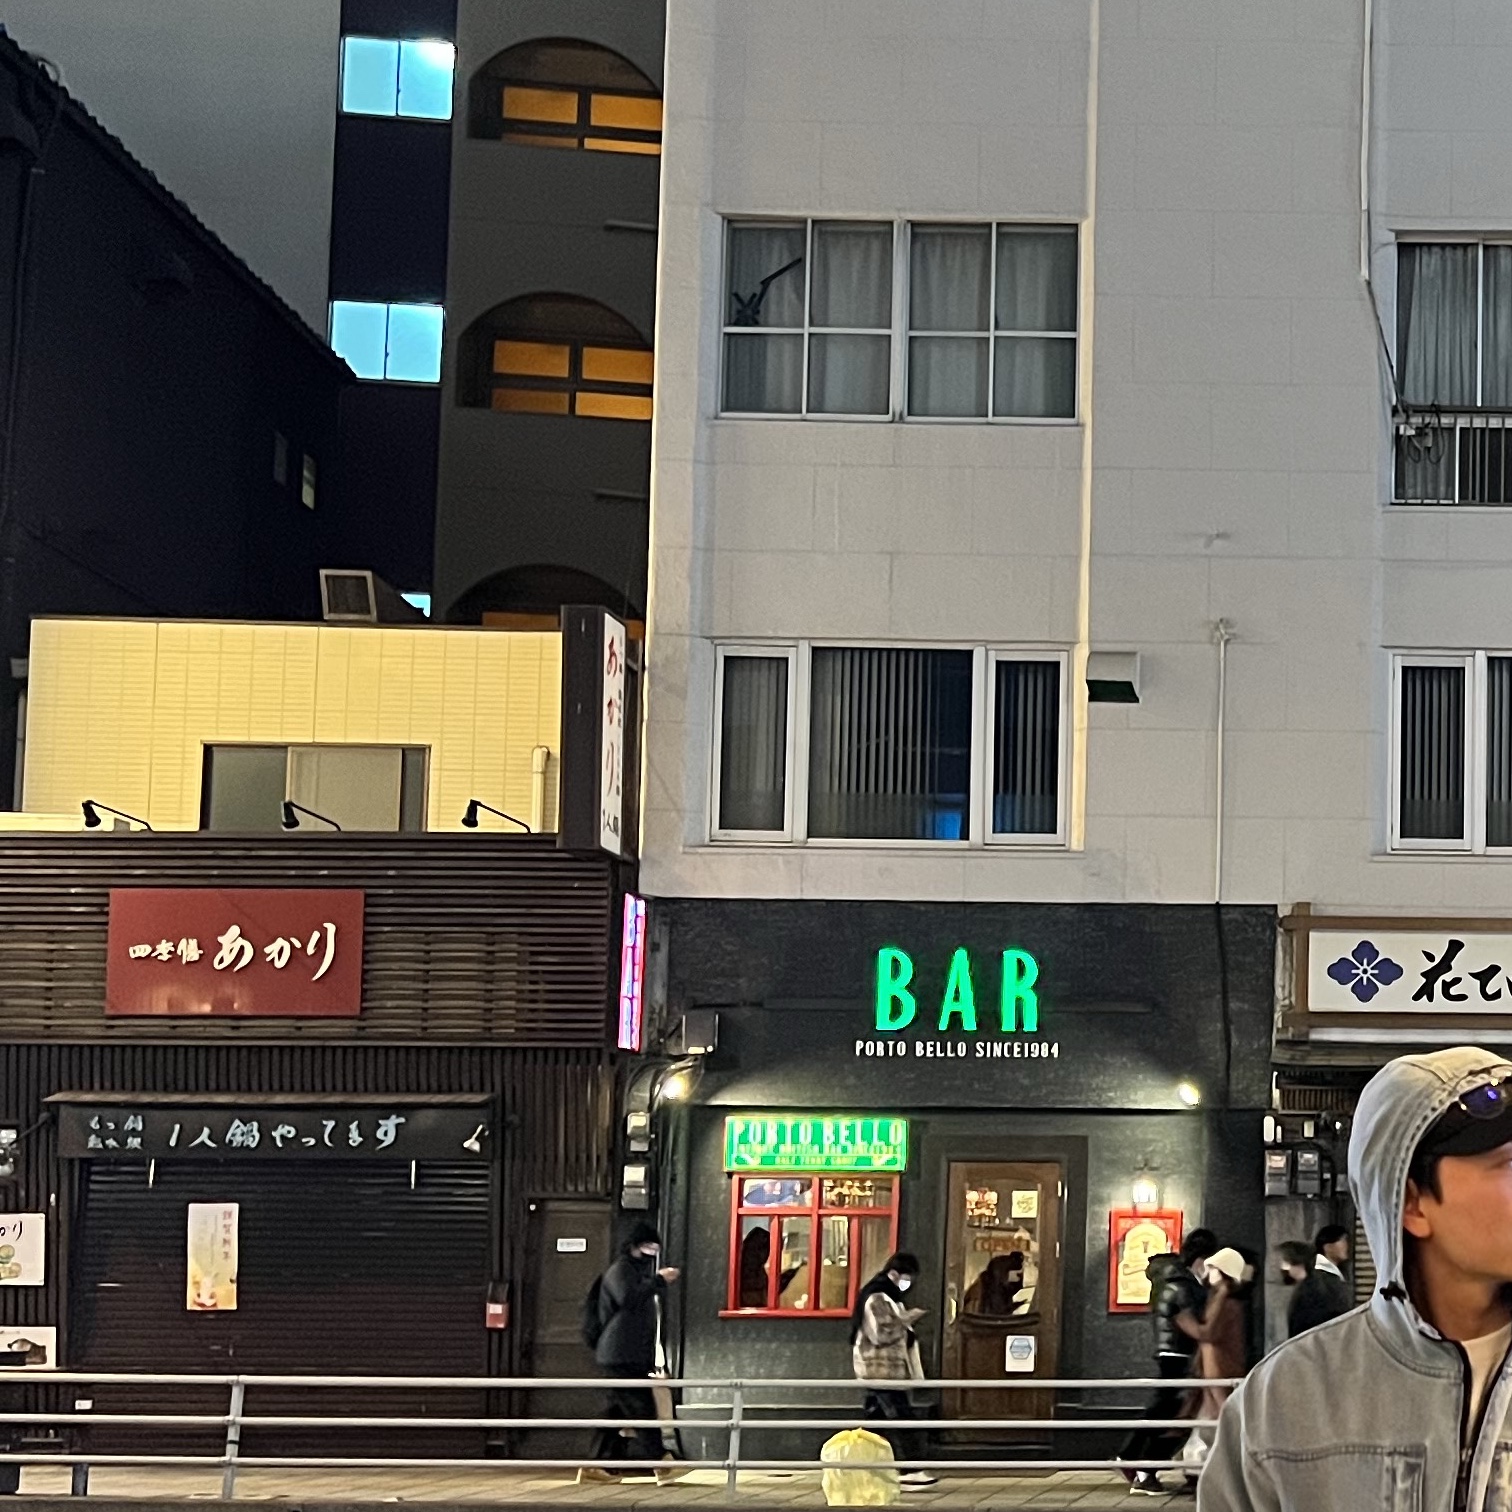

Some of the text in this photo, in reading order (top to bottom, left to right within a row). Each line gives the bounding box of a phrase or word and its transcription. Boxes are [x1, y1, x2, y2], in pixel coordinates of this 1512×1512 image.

[213, 922, 337, 982] あかり
[874, 946, 1040, 1032] BAR
[854, 1040, 907, 1057] PORTO
[915, 1041, 967, 1058] BELLO
[733, 1119, 903, 1147] PORTO BELLO
